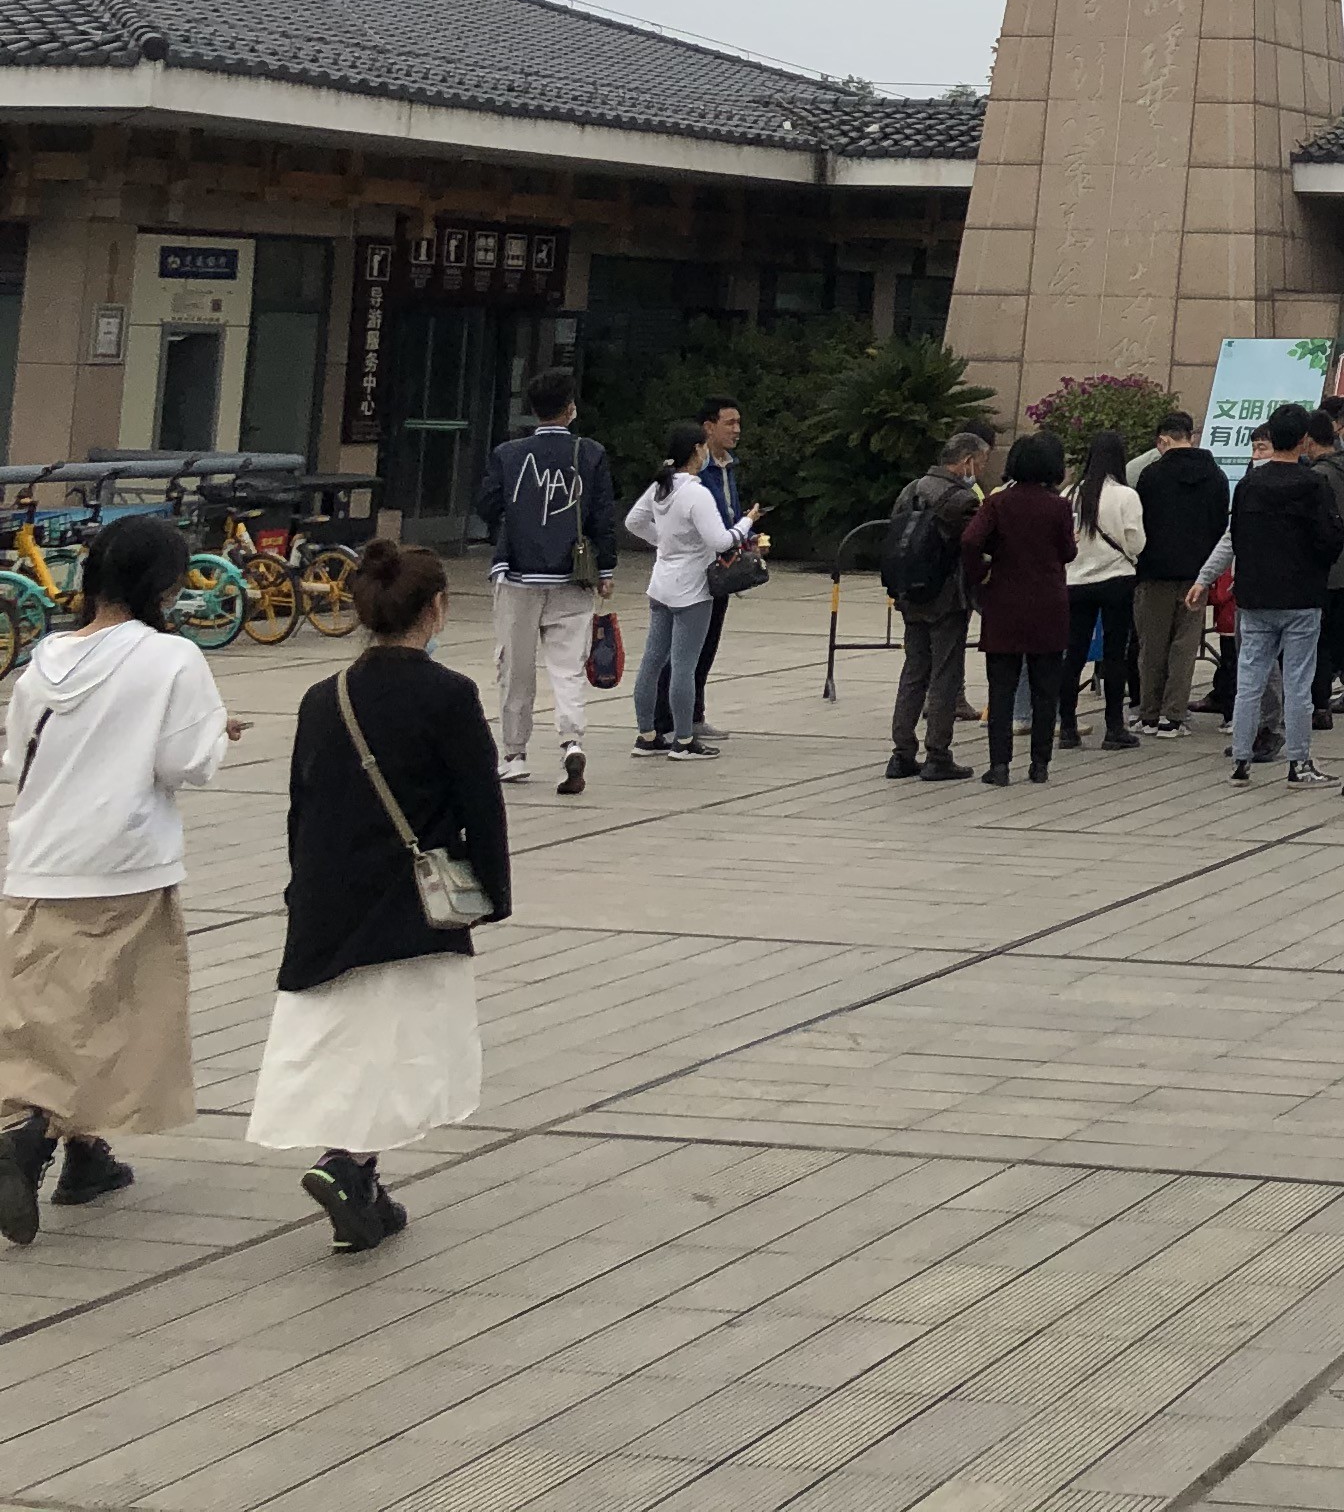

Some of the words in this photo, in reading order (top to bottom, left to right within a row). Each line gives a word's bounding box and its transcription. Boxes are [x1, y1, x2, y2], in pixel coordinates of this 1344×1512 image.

[360, 287, 385, 416] 导游服务中心
